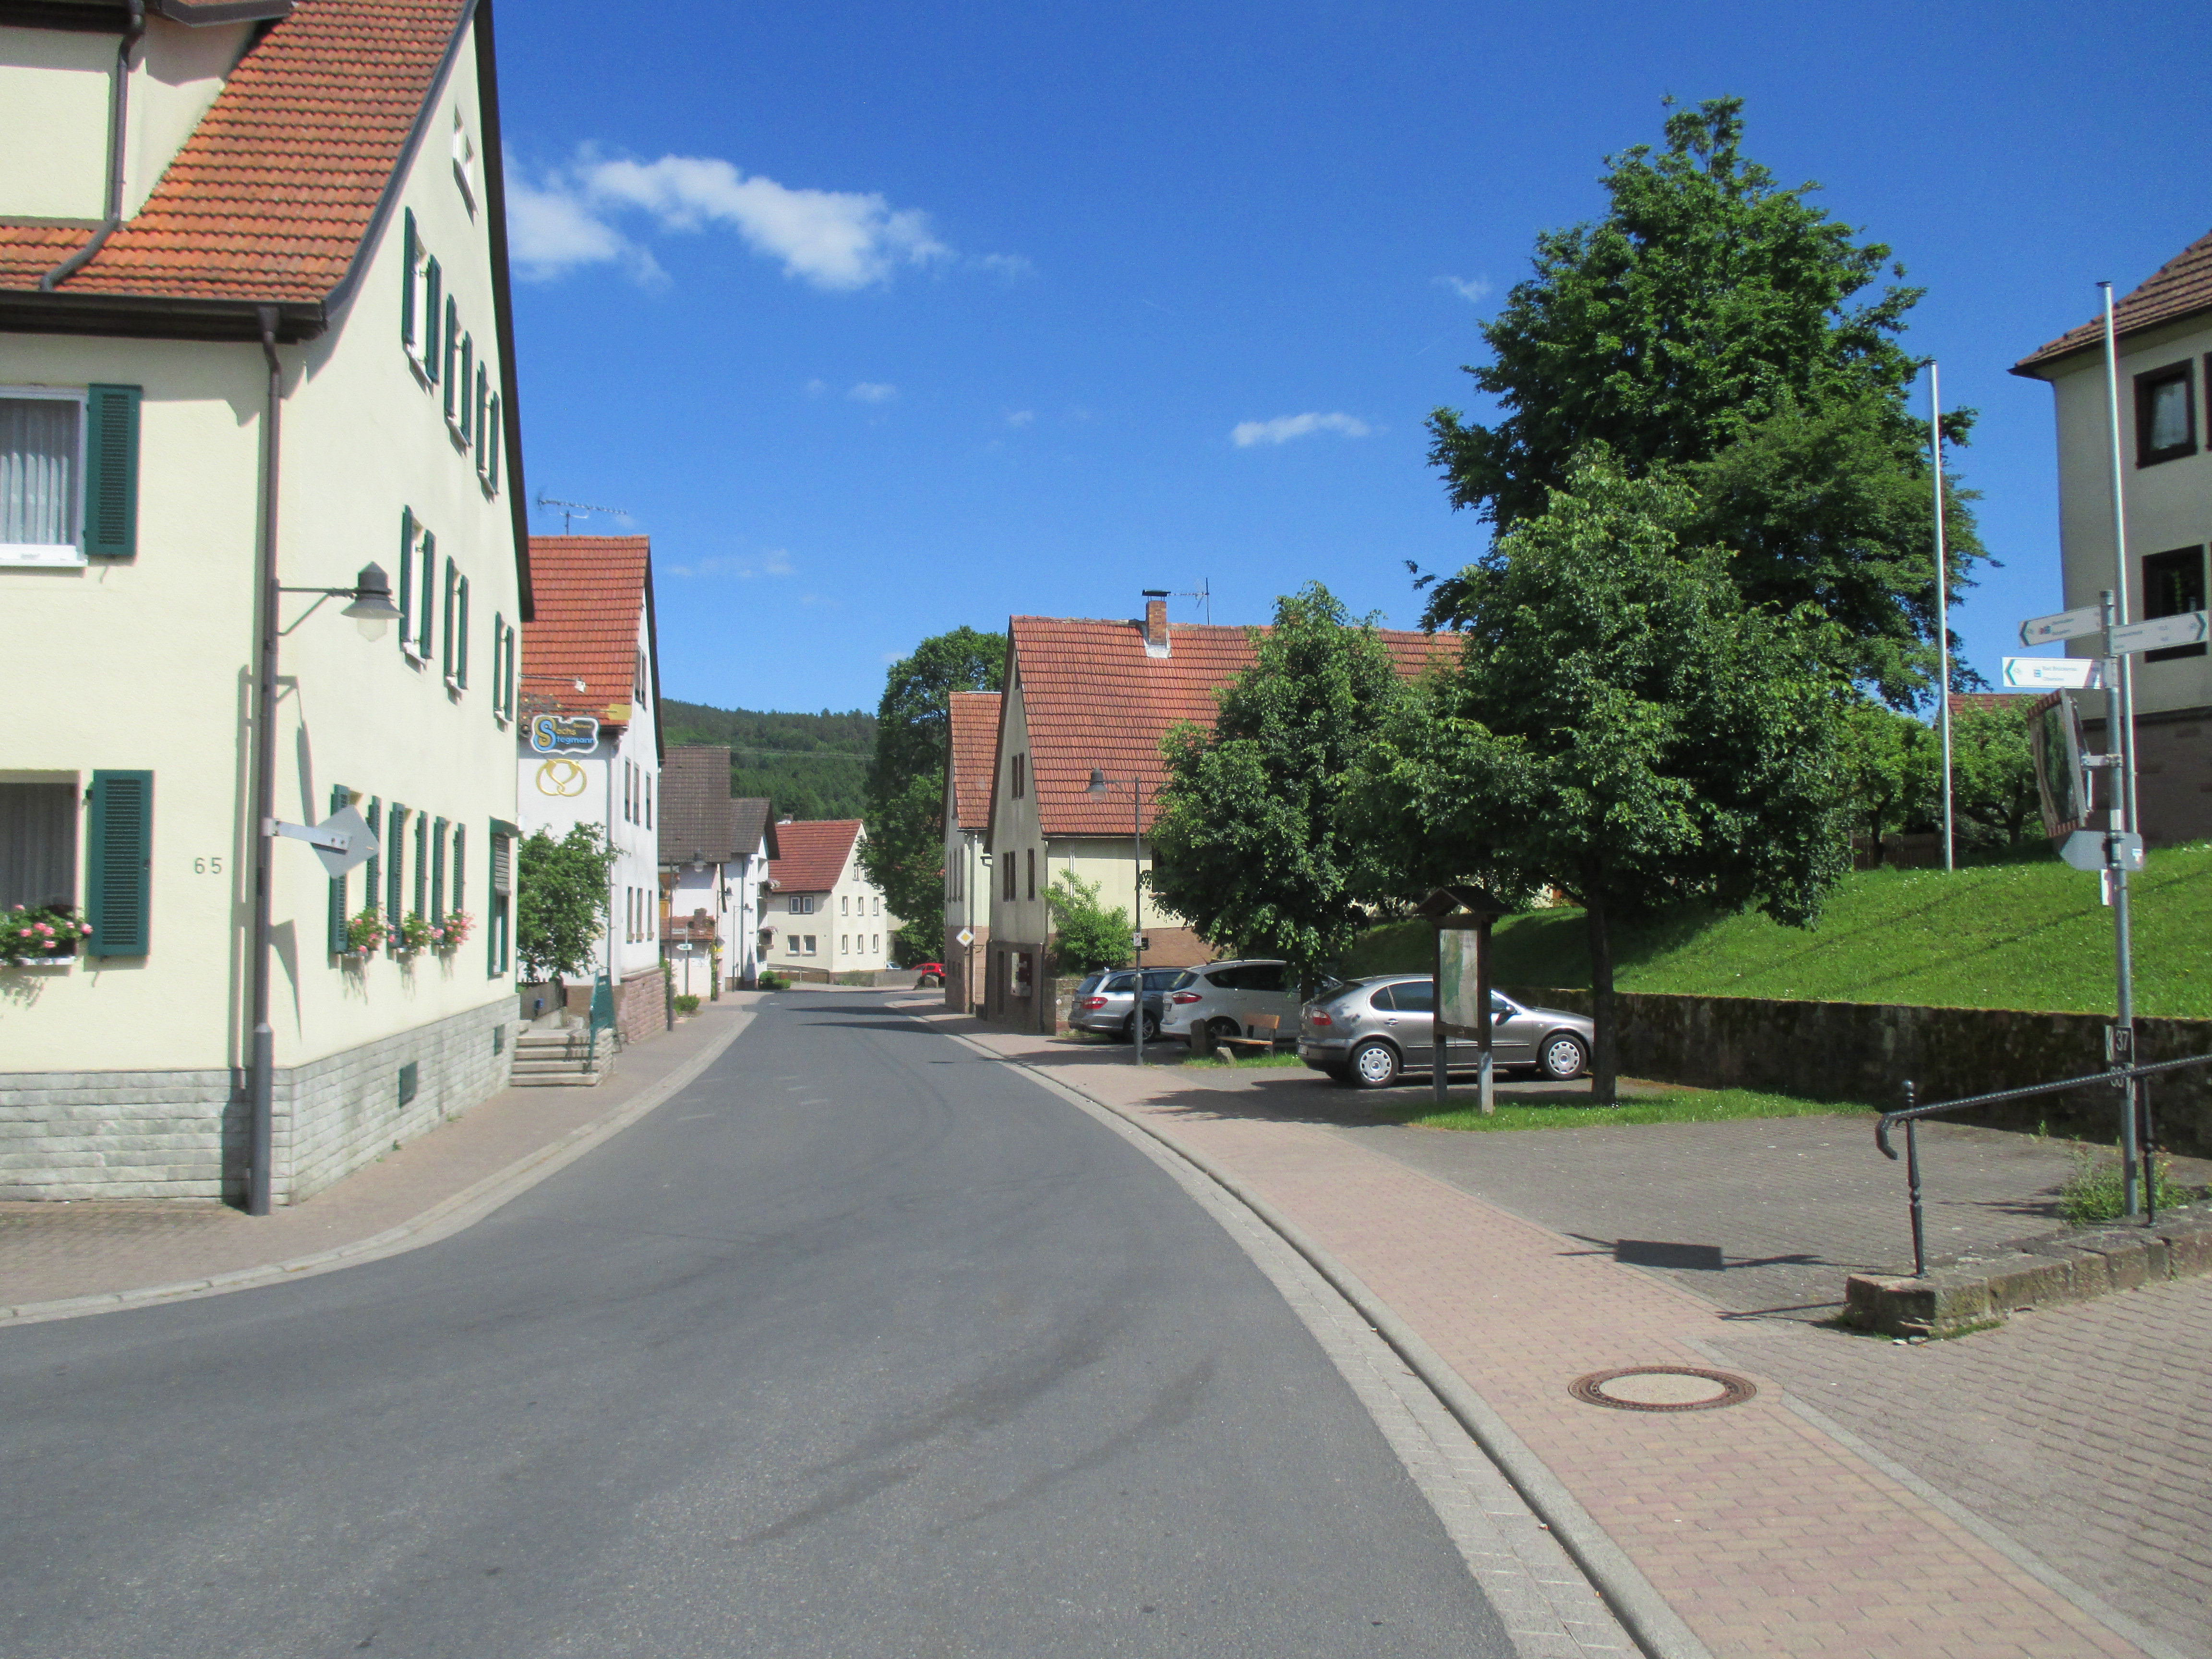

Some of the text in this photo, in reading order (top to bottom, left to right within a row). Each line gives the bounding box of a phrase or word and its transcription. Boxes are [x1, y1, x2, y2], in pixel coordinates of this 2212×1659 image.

[534, 720, 595, 751] Stegmann
[194, 857, 222, 874] 65
[2116, 1030, 2129, 1051] 37
